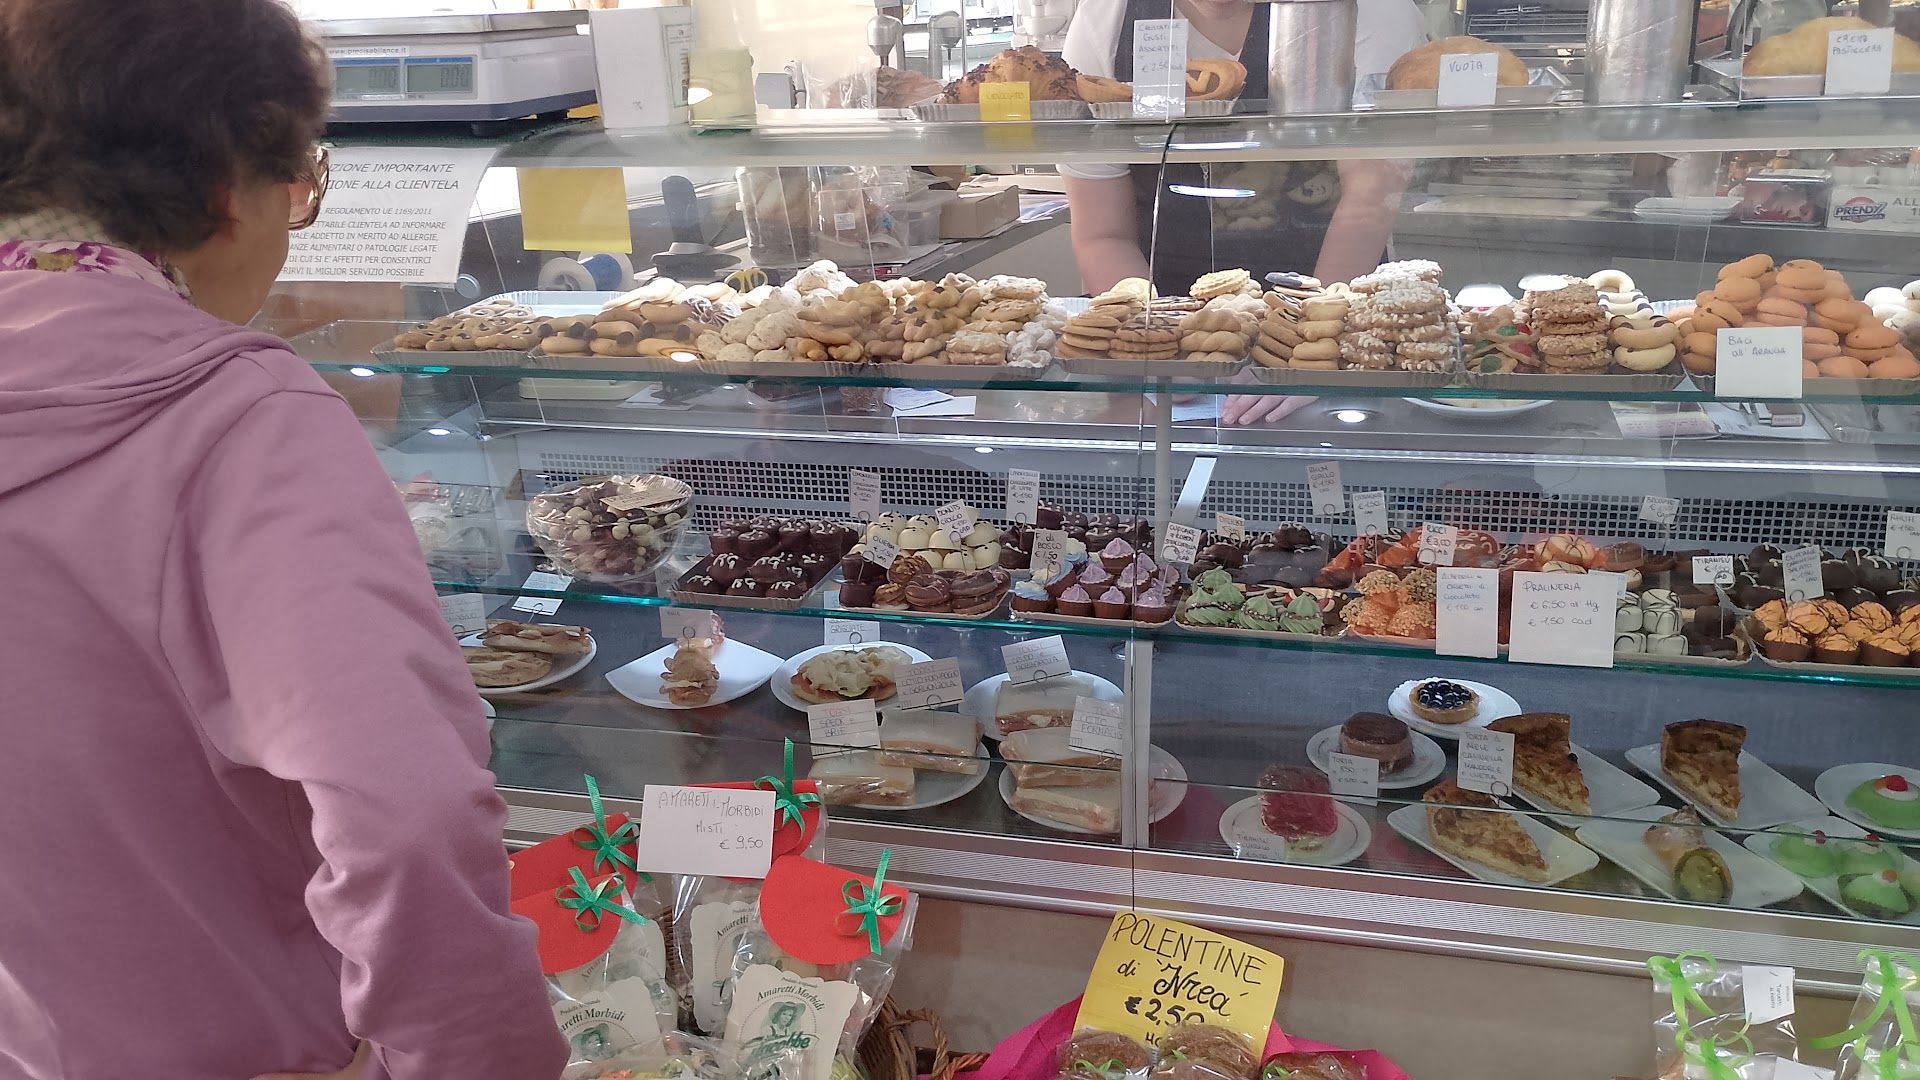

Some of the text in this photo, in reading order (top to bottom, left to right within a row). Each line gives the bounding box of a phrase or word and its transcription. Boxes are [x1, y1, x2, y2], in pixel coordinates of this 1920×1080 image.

[1449, 60, 1484, 75] VUOTA
[372, 163, 456, 173] IMPORTANTE
[361, 180, 460, 190] ALLA CLIENTELA
[325, 207, 381, 215] REGOLAMENTO
[382, 207, 392, 215] UE
[1834, 202, 1888, 216] PRENDY
[347, 221, 388, 229] CLIENTELA
[401, 222, 447, 230] INFORMARE
[310, 232, 345, 240] ADDETTO
[400, 233, 439, 241] ALLERGIE,
[364, 244, 408, 252] PATOLOGIE
[409, 244, 438, 252] LEGATE
[299, 255, 313, 263] CUI
[380, 256, 431, 264] CONSENTIRCI
[305, 267, 313, 275] IL
[349, 268, 384, 276] SERVIZIO
[385, 268, 425, 276] POSSIBILE
[1310, 471, 1335, 480] GIALLO
[1426, 524, 1447, 535] RICCI
[1037, 541, 1063, 550] BOSCO
[1523, 580, 1582, 592] PRALINERIA
[1530, 602, 1539, 610] €
[1528, 617, 1592, 627] € 1,50 cad
[819, 716, 845, 729] SPECK
[824, 726, 847, 738] BRIE
[1464, 731, 1489, 741] TORTA
[1466, 742, 1489, 752] MELE
[1331, 756, 1353, 765] TORTA
[1462, 751, 1503, 763] CANNELLA
[719, 835, 764, 850] € 9,50
[716, 914, 750, 941] Amaretti
[1112, 912, 1268, 985] POLENTINE
[1117, 959, 1141, 977] di
[757, 985, 826, 1012] Amaretti Morbidi
[584, 1007, 626, 1022] Morbidi
